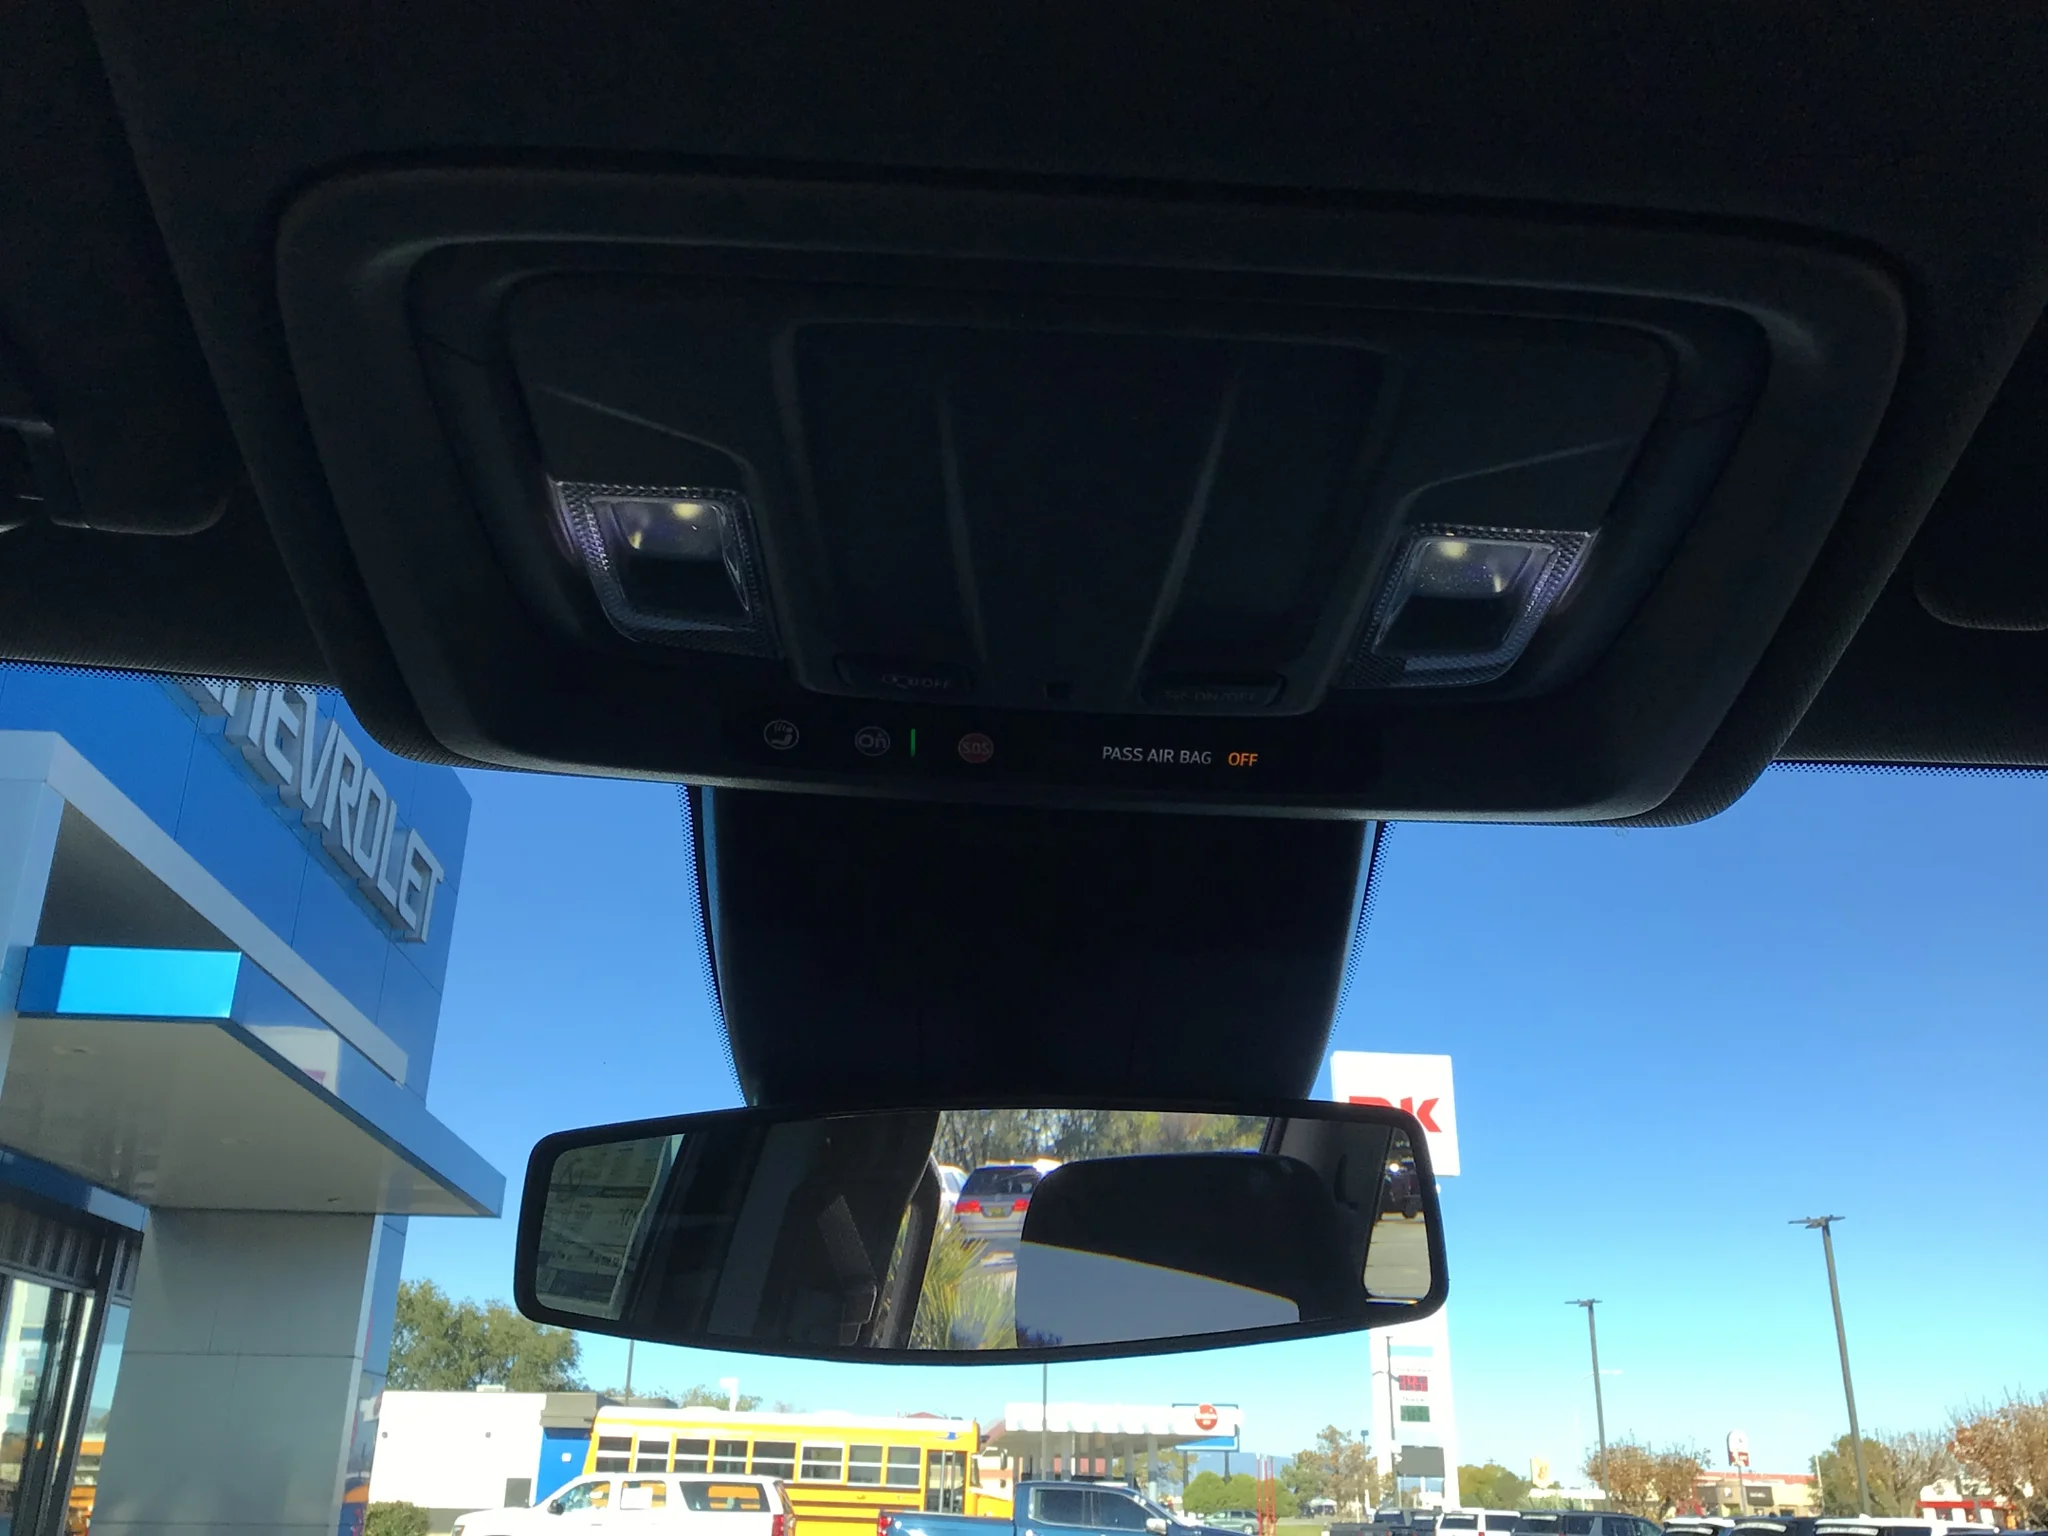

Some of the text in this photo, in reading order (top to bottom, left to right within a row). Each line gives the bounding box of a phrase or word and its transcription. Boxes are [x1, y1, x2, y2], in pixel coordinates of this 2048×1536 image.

[963, 742, 990, 755] SOS
[1102, 746, 1258, 766] PASS AIR BAG OFF
[200, 680, 444, 943] EVROLET
[1348, 1095, 1442, 1133] K
